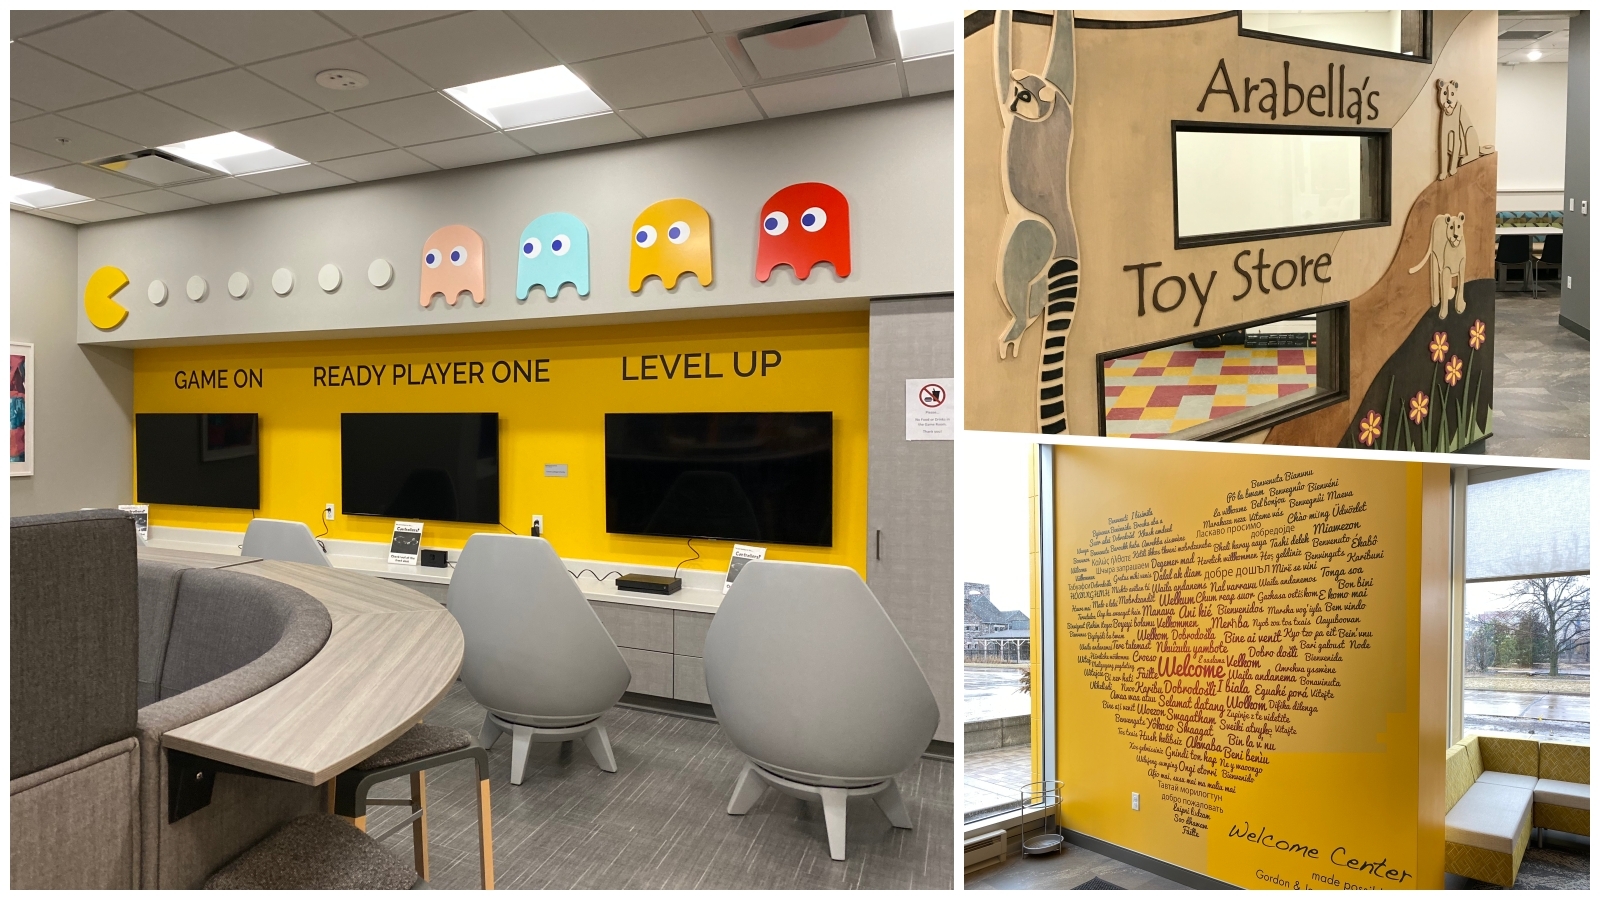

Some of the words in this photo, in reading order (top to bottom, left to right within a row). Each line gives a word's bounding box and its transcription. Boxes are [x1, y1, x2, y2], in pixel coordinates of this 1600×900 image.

[1196, 57, 1380, 124] Arabella's
[1122, 261, 1218, 327] Toy
[1232, 248, 1333, 301] Store
[622, 352, 724, 381] LEVEL
[733, 349, 782, 378] UP
[174, 370, 228, 389] GAME
[233, 368, 263, 388] ON
[313, 365, 386, 387] READY
[392, 361, 484, 385] PLAYER
[491, 359, 550, 383] ONE
[1196, 526, 1226, 539] Ласкаво
[1226, 522, 1262, 534] просимо
[1270, 536, 1289, 548] Tashi
[1312, 534, 1350, 548] Benvenuto
[1180, 552, 1195, 564] mad
[1346, 550, 1385, 563] Karibuni
[1204, 566, 1234, 581] добре
[1236, 564, 1270, 578] дошъл
[1320, 566, 1346, 582] Tonga
[1336, 578, 1355, 590] Bon
[1356, 576, 1374, 588] bini
[1159, 590, 1196, 606] Welkum
[1318, 589, 1326, 601] E
[1328, 588, 1350, 600] komo
[1351, 588, 1368, 598] mai
[1142, 604, 1176, 617] Manava
[1178, 605, 1196, 619] Ani
[1216, 601, 1264, 616] Bienvenidos
[1324, 601, 1342, 612] Bem
[1344, 598, 1366, 611] vindo
[1156, 616, 1200, 629] Velkommen
[1136, 627, 1169, 642] Welkom
[1224, 630, 1246, 644] Bine
[1246, 632, 1257, 643] ai
[1258, 629, 1282, 644] venit
[1283, 628, 1301, 642] Kyo
[1192, 640, 1229, 660] yambote
[1248, 645, 1276, 658] Dobro
[1300, 640, 1318, 650] Bari
[1132, 650, 1158, 663] Croeso
[1304, 652, 1344, 662] Bienvenida
[1158, 653, 1226, 679] Welcome
[1254, 668, 1298, 682] andanema
[1134, 680, 1164, 697] Karibu
[1216, 679, 1224, 693] I
[1225, 678, 1251, 694] biala
[1254, 684, 1287, 700] Eguahé
[1158, 694, 1192, 709] Selamat
[1194, 696, 1226, 717] datang
[1226, 694, 1268, 712] Wolkom
[1166, 708, 1217, 725] Swagatham
[1228, 733, 1244, 746] Bin
[1222, 746, 1244, 760] Beni
[1178, 760, 1196, 778] Ongi
[1157, 780, 1179, 792] Тавтай
[1162, 793, 1182, 804] добро
[1182, 798, 1224, 814] пожаловать
[1228, 821, 1320, 859] Welcome
[1330, 846, 1412, 883] Center
[1255, 869, 1290, 888] Gordon
[1312, 872, 1341, 887] made
